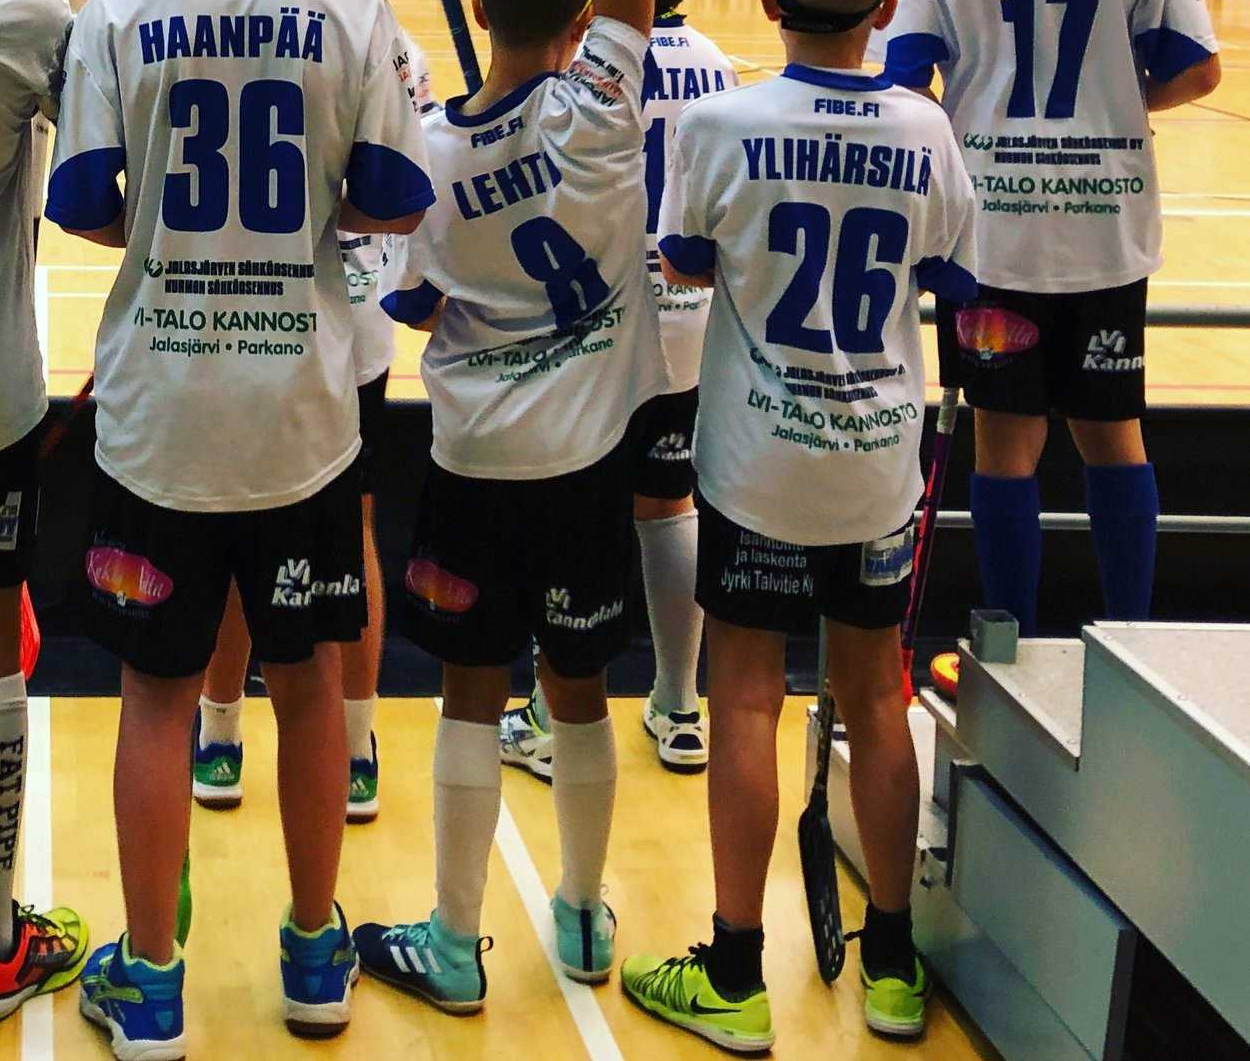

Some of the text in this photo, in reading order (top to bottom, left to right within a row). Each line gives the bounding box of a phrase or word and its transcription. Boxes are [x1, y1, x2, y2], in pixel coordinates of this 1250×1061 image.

[139, 7, 326, 65] HAANPÄÄ
[814, 98, 879, 118] FIBE.FI
[162, 79, 305, 234] 36
[742, 133, 932, 196] YLIHÄRSILÄ
[1042, 177, 1144, 195] KANNOSTO
[982, 198, 1121, 216] Jalasjärvi Parkano
[511, 216, 611, 329] 8
[765, 202, 909, 354] 26
[150, 336, 304, 357] Jalasjärvi Parkano
[747, 388, 918, 432] LVI-TALO KANNOSTO
[771, 425, 839, 451] Jalasjärvi
[735, 549, 807, 568] ja laskenta
[721, 568, 751, 592] Jyrki
[754, 569, 800, 594] Talvitie
